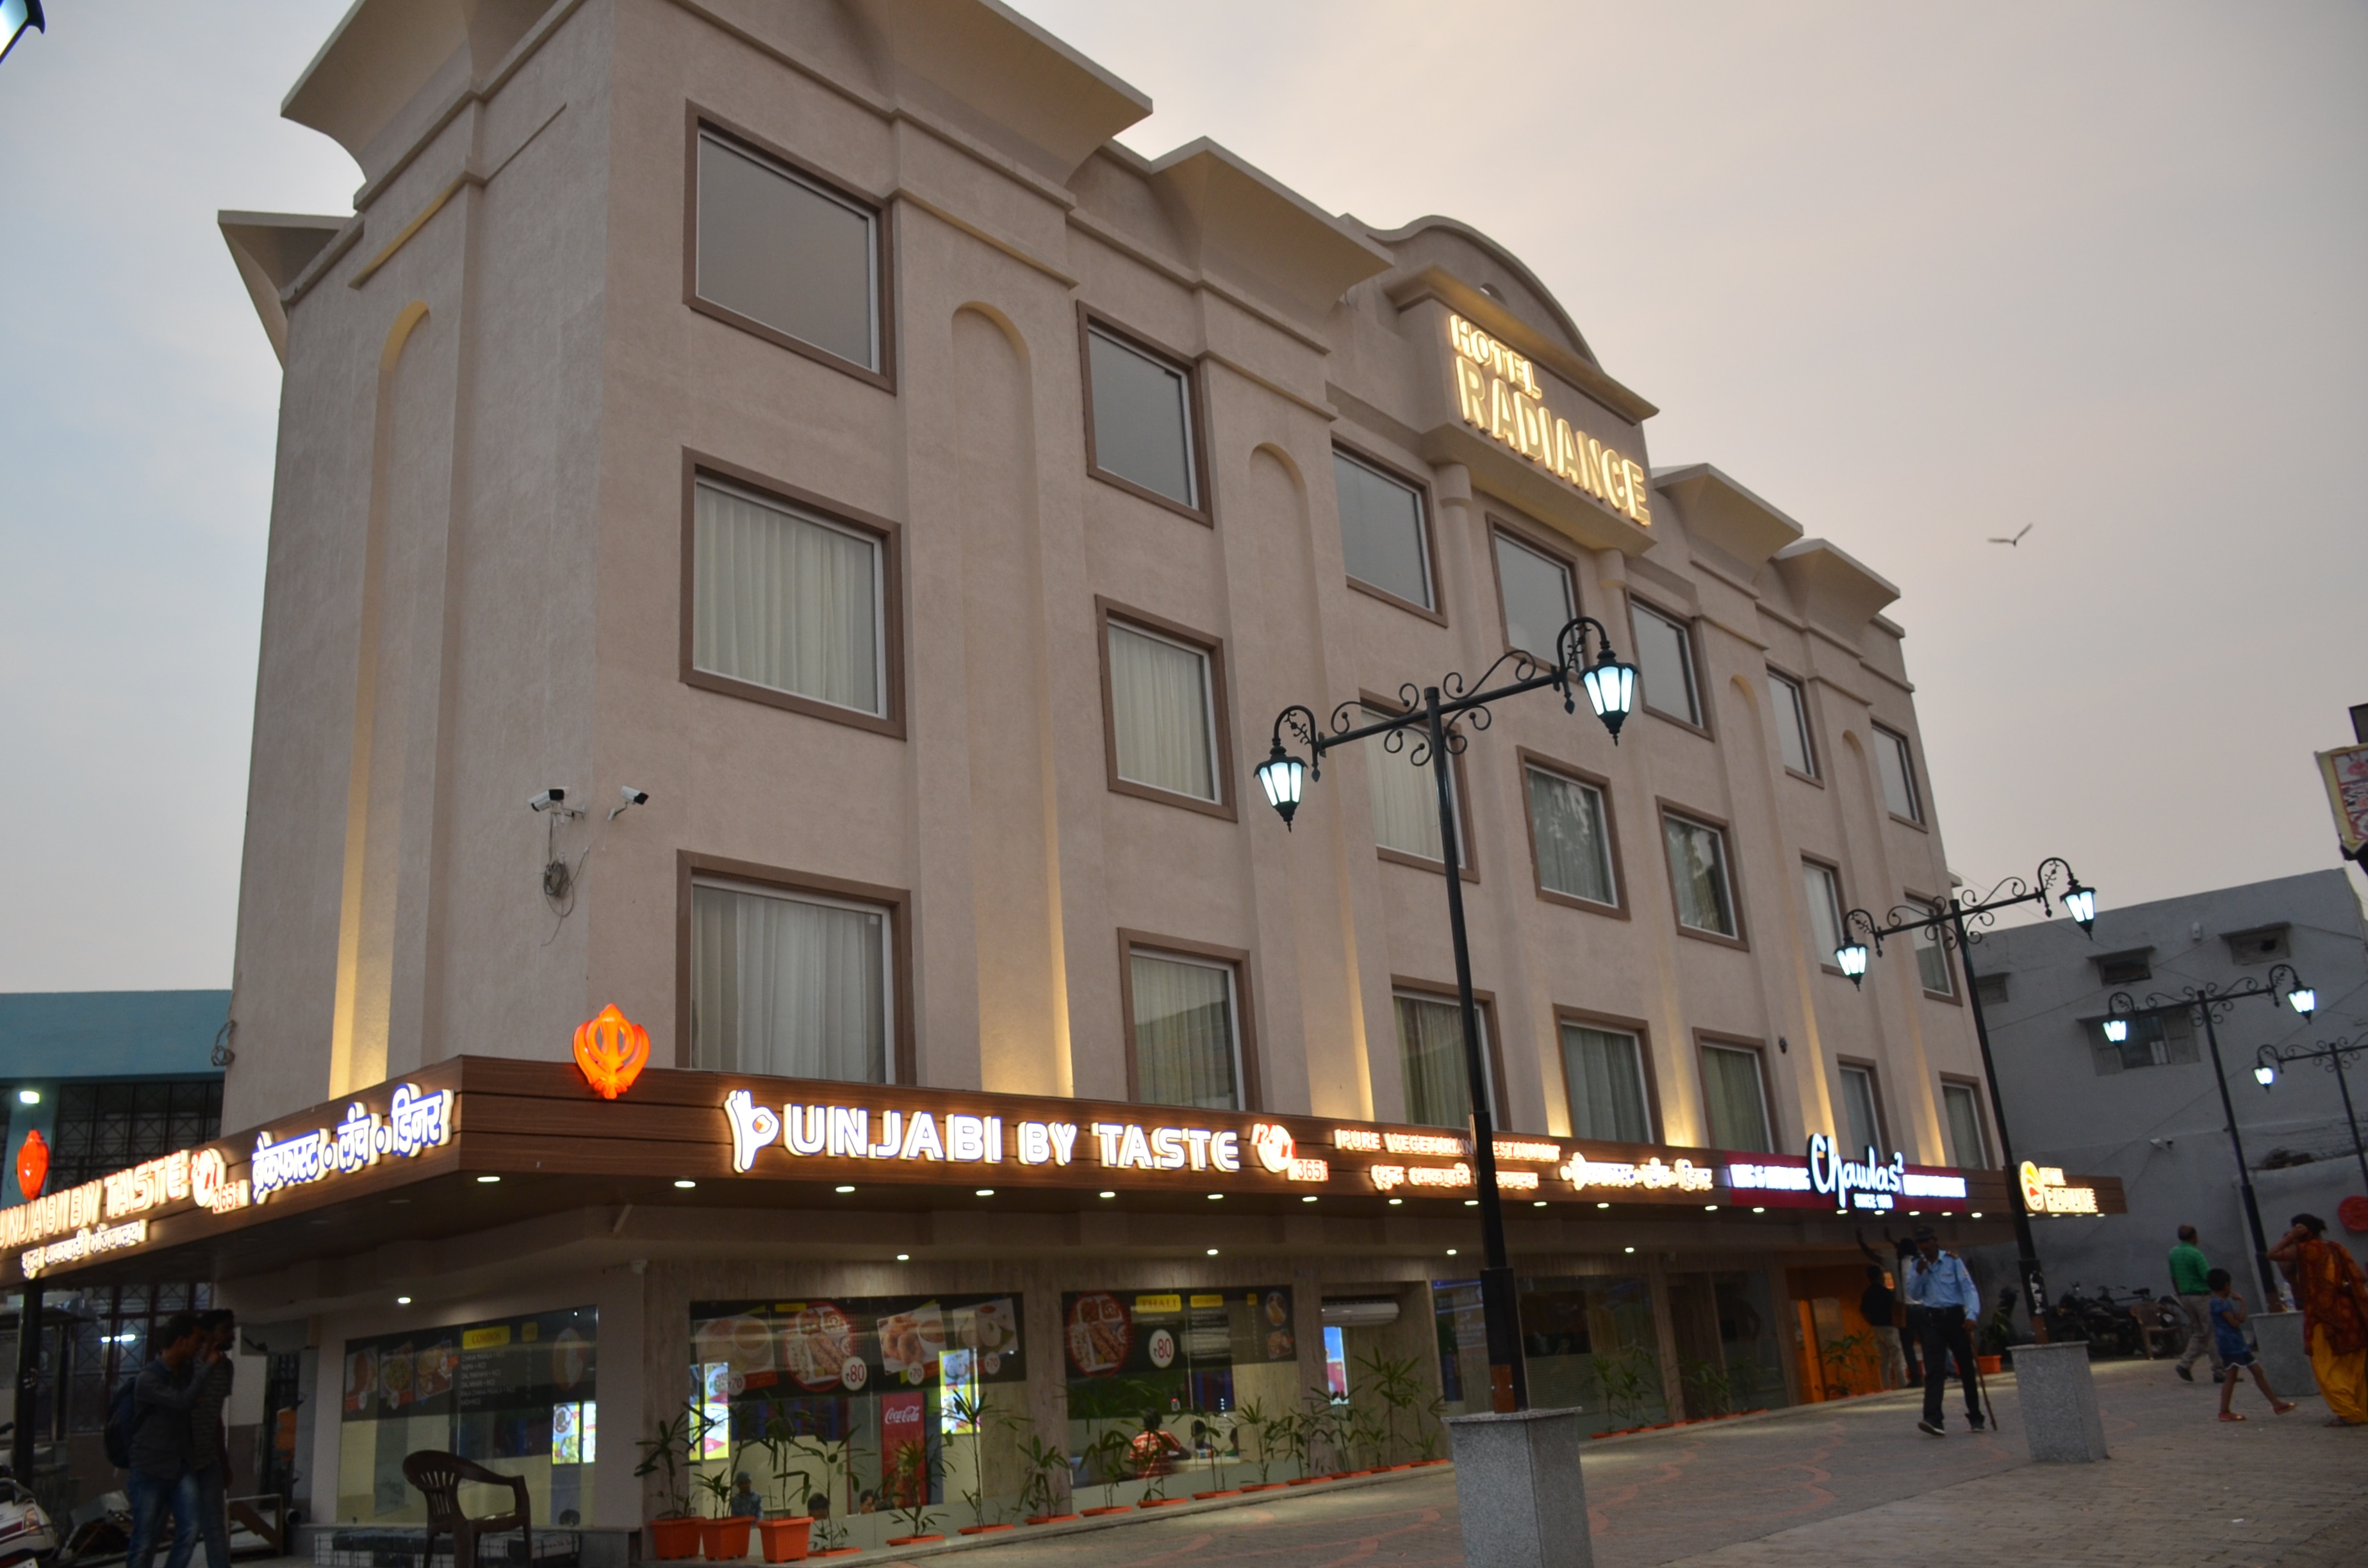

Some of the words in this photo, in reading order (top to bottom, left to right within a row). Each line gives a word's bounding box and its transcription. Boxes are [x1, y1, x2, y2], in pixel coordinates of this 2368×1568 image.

[1450, 314, 1542, 400] HOTEL
[1456, 355, 1651, 527] RADIANCE
[337, 1102, 382, 1173] लंच
[391, 1082, 454, 1157] डिनर
[725, 1090, 1003, 1173] PUNJABI
[1017, 1122, 1077, 1166] BY
[1091, 1122, 1240, 1172] TASTE
[1259, 1124, 1276, 1144] 24
[1335, 1129, 1381, 1152] PURE
[1383, 1132, 1474, 1157] VEGETARIAN
[1492, 1141, 1561, 1163] ESTAURANT
[69, 1179, 103, 1229] BY
[104, 1149, 191, 1219] TASTE
[213, 1184, 234, 1212] 365
[1297, 1160, 1322, 1179] 365
